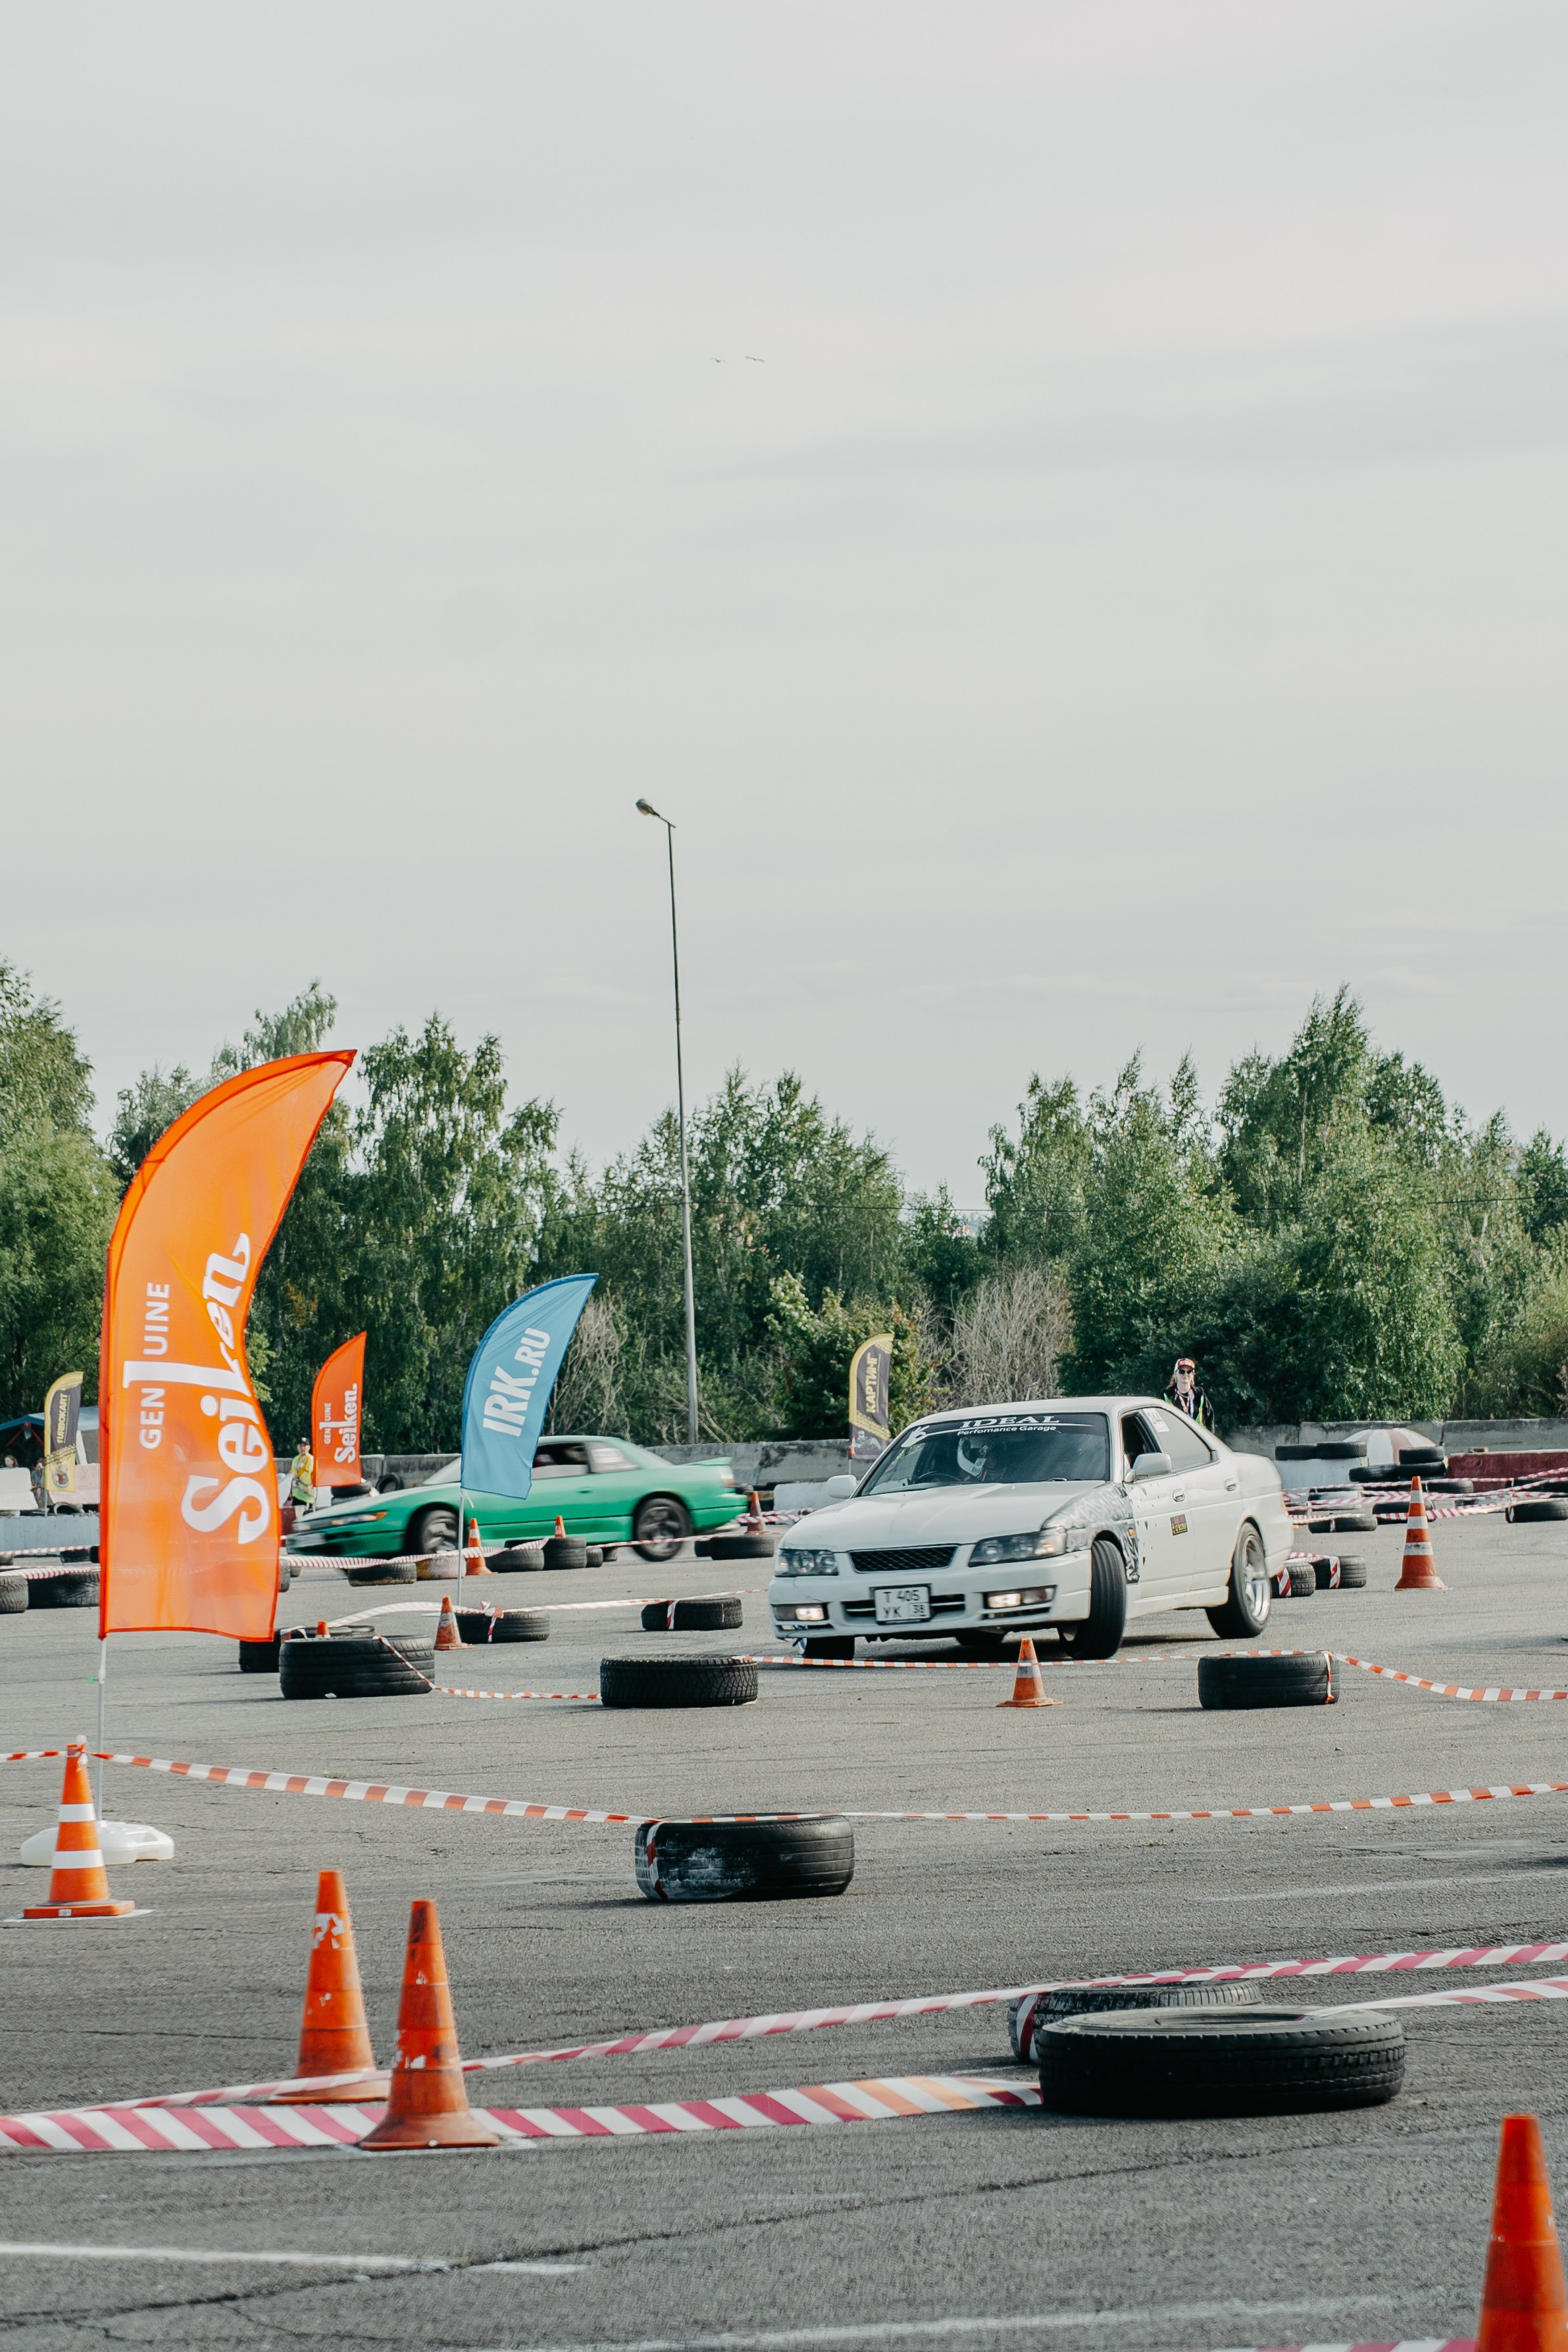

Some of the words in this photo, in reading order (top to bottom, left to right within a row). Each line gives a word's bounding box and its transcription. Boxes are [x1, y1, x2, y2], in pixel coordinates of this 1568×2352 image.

[122, 1232, 271, 1545] Seiken
[482, 1327, 551, 1437] IRK.RU
[865, 1352, 878, 1414] КАРТИНГ
[57, 1393, 68, 1444] TURBOKART
[319, 1383, 358, 1464] Seiken
[957, 1427, 1018, 1436] Perfomance
[959, 1416, 1060, 1429] IDEAL
[882, 1606, 902, 1618] УК
[913, 1604, 926, 1614] 38
[896, 1589, 921, 1602] 405
